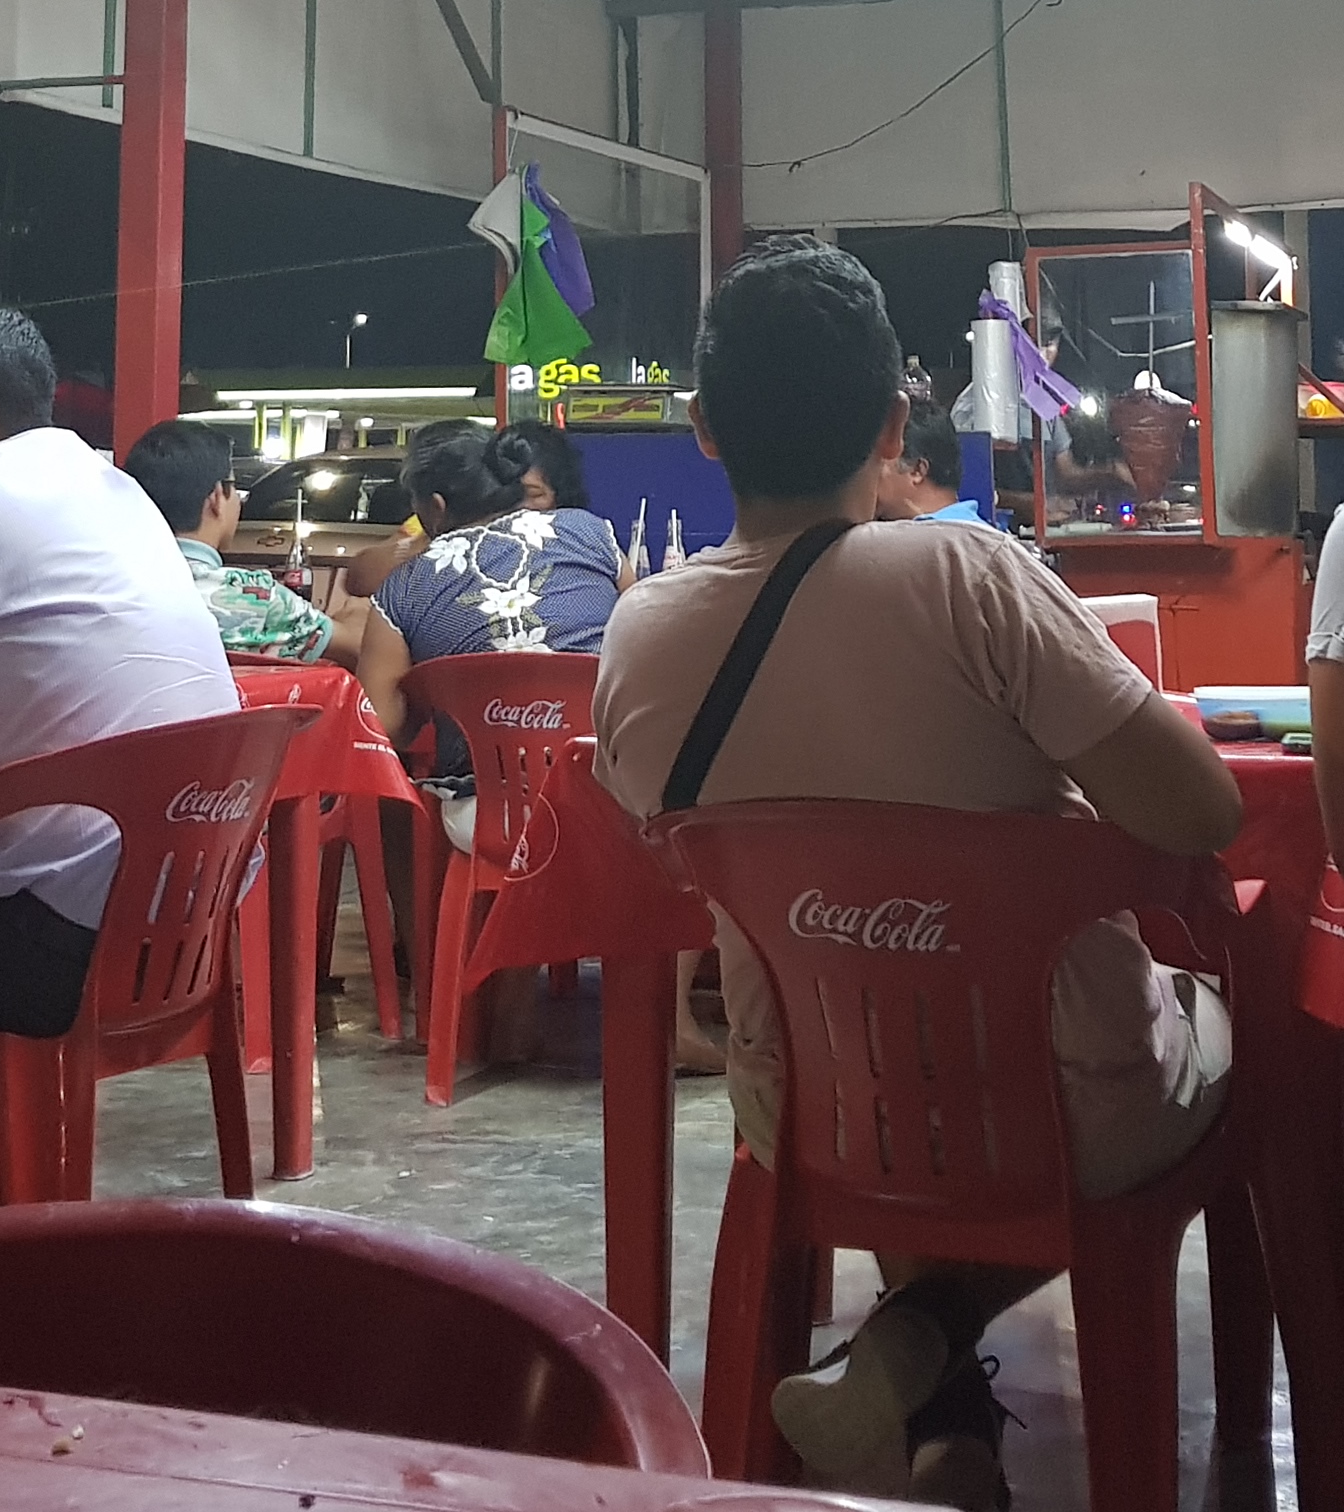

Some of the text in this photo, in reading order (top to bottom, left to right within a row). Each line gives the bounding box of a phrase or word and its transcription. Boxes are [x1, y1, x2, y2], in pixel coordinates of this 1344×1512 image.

[538, 358, 601, 399] gas
[484, 698, 567, 730] Coca-Cola
[166, 777, 255, 823] Coca-Cola
[788, 888, 952, 953] Coca-Cola
